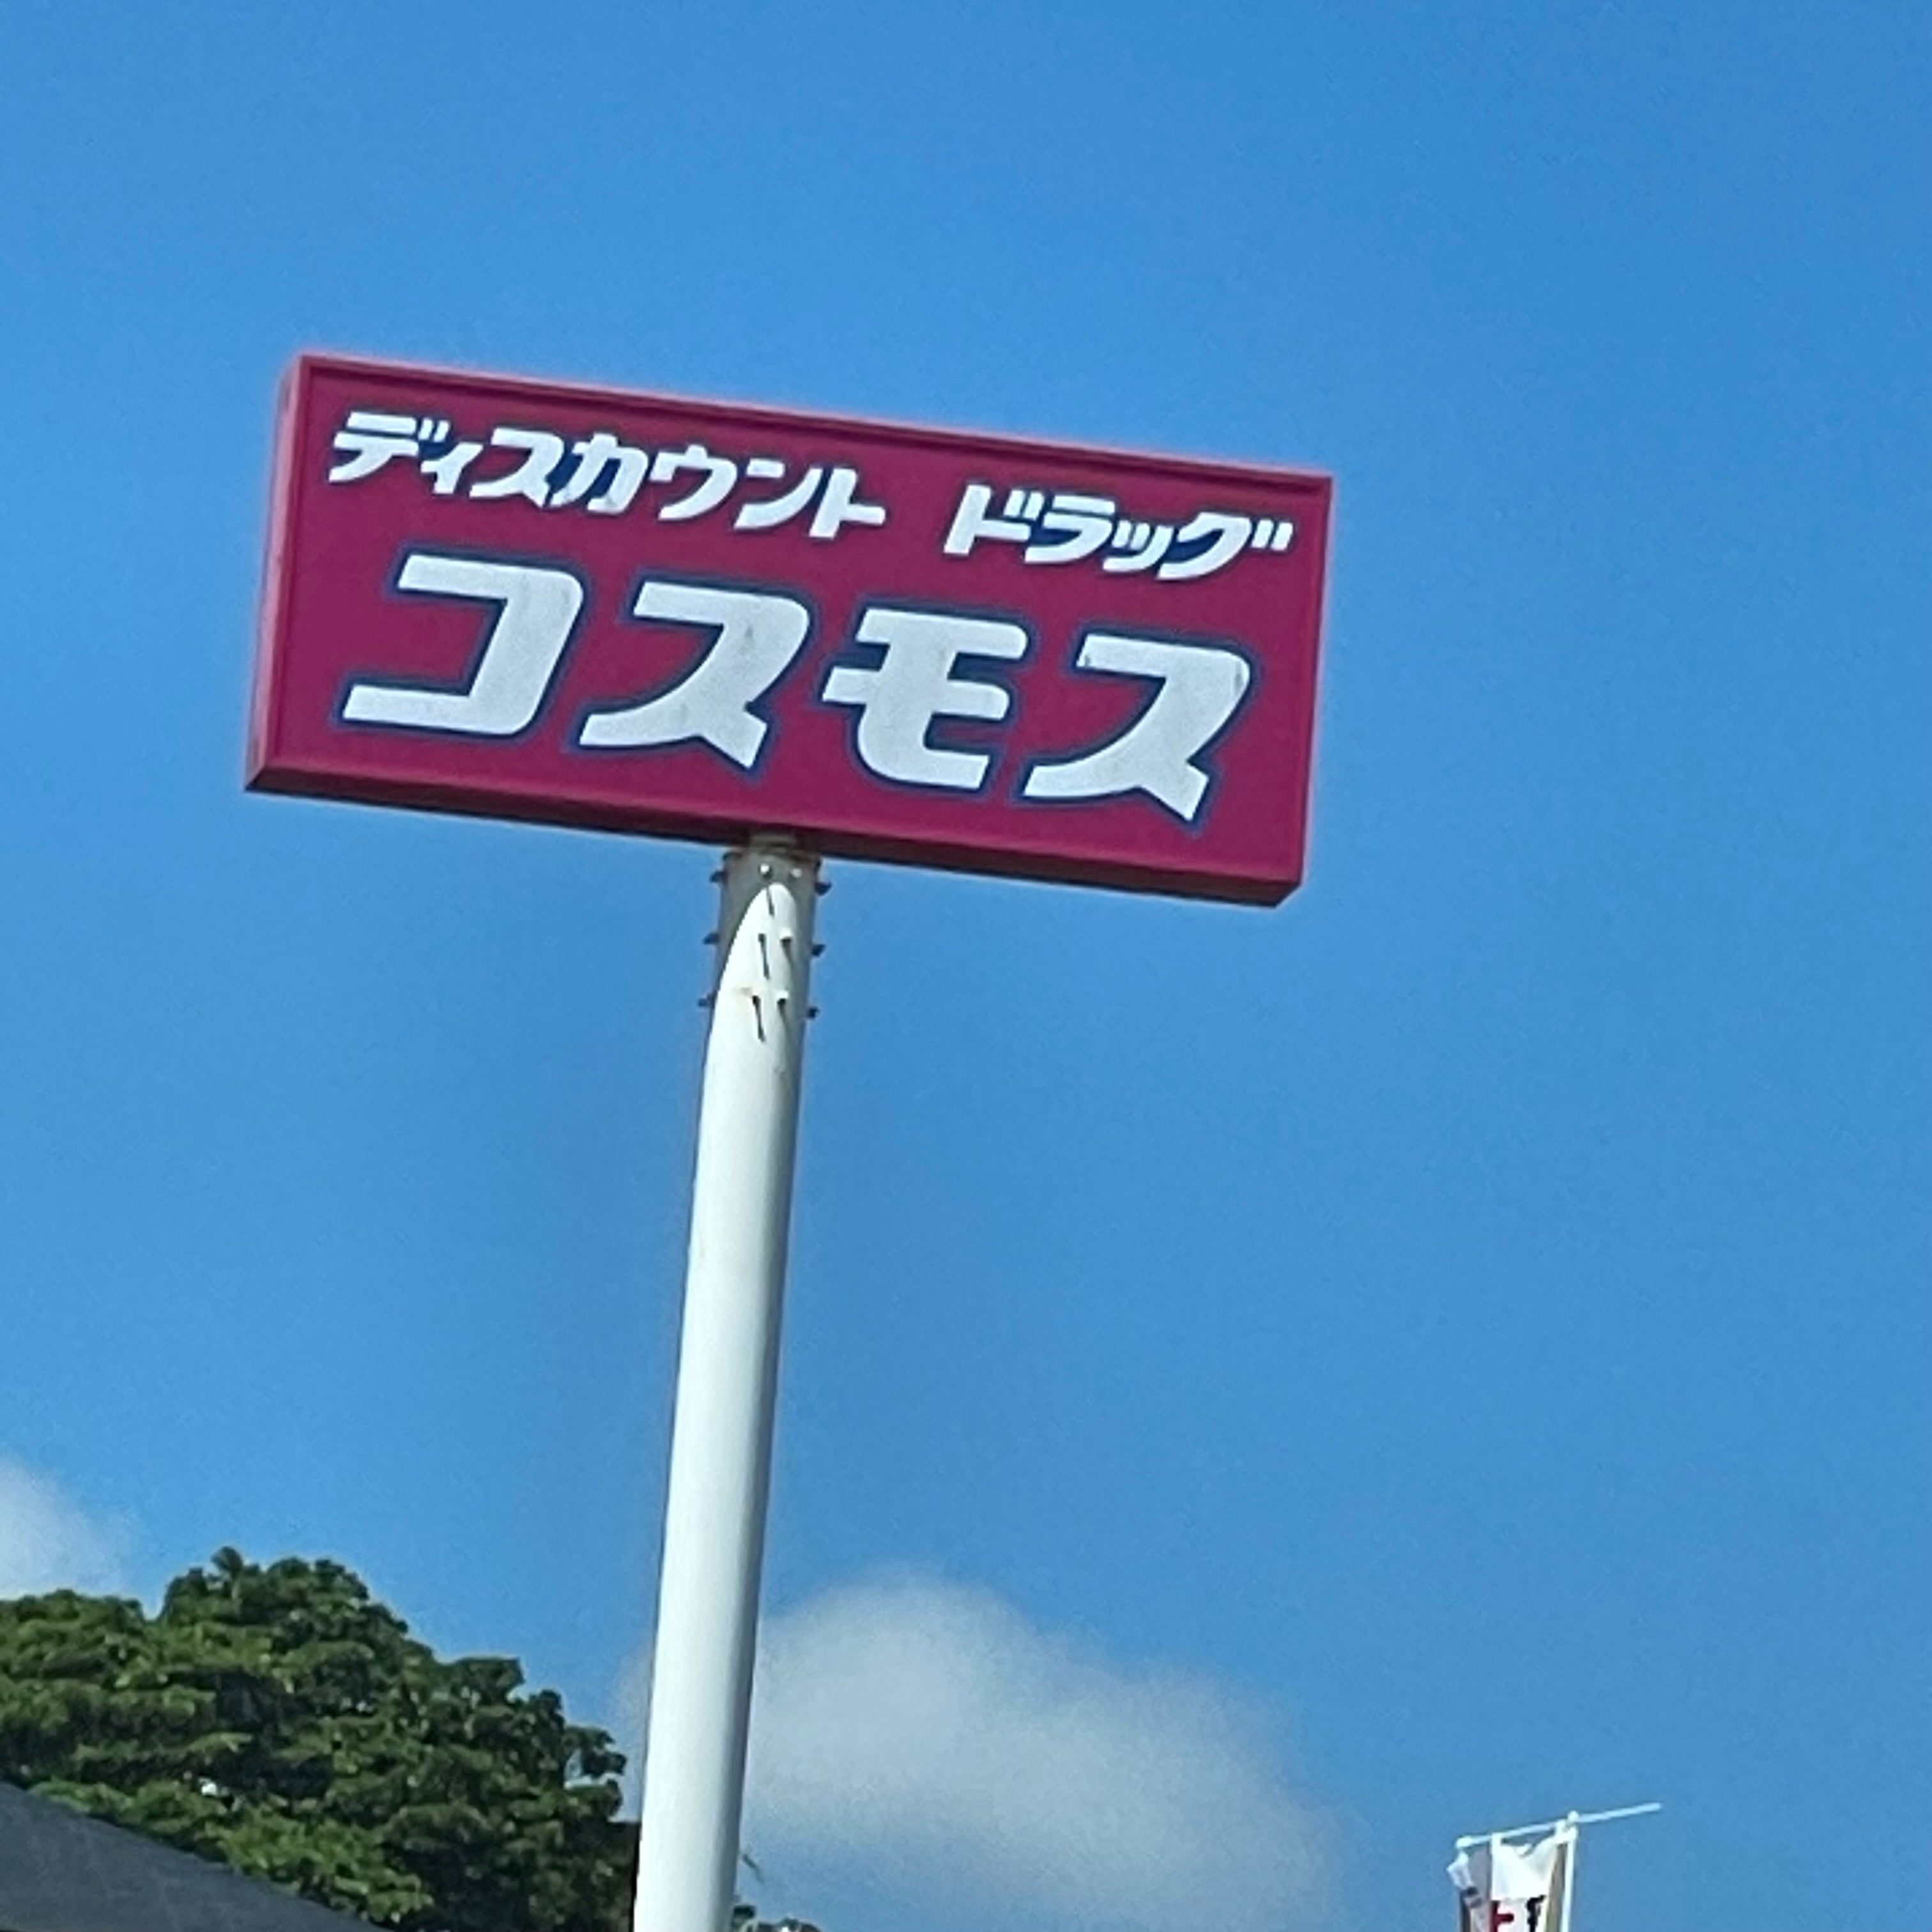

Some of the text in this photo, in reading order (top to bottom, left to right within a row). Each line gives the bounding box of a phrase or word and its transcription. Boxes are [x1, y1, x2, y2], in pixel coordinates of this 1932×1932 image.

[328, 411, 1294, 580] ディスカウント ドラッグ
[342, 553, 1252, 822] コスモス
